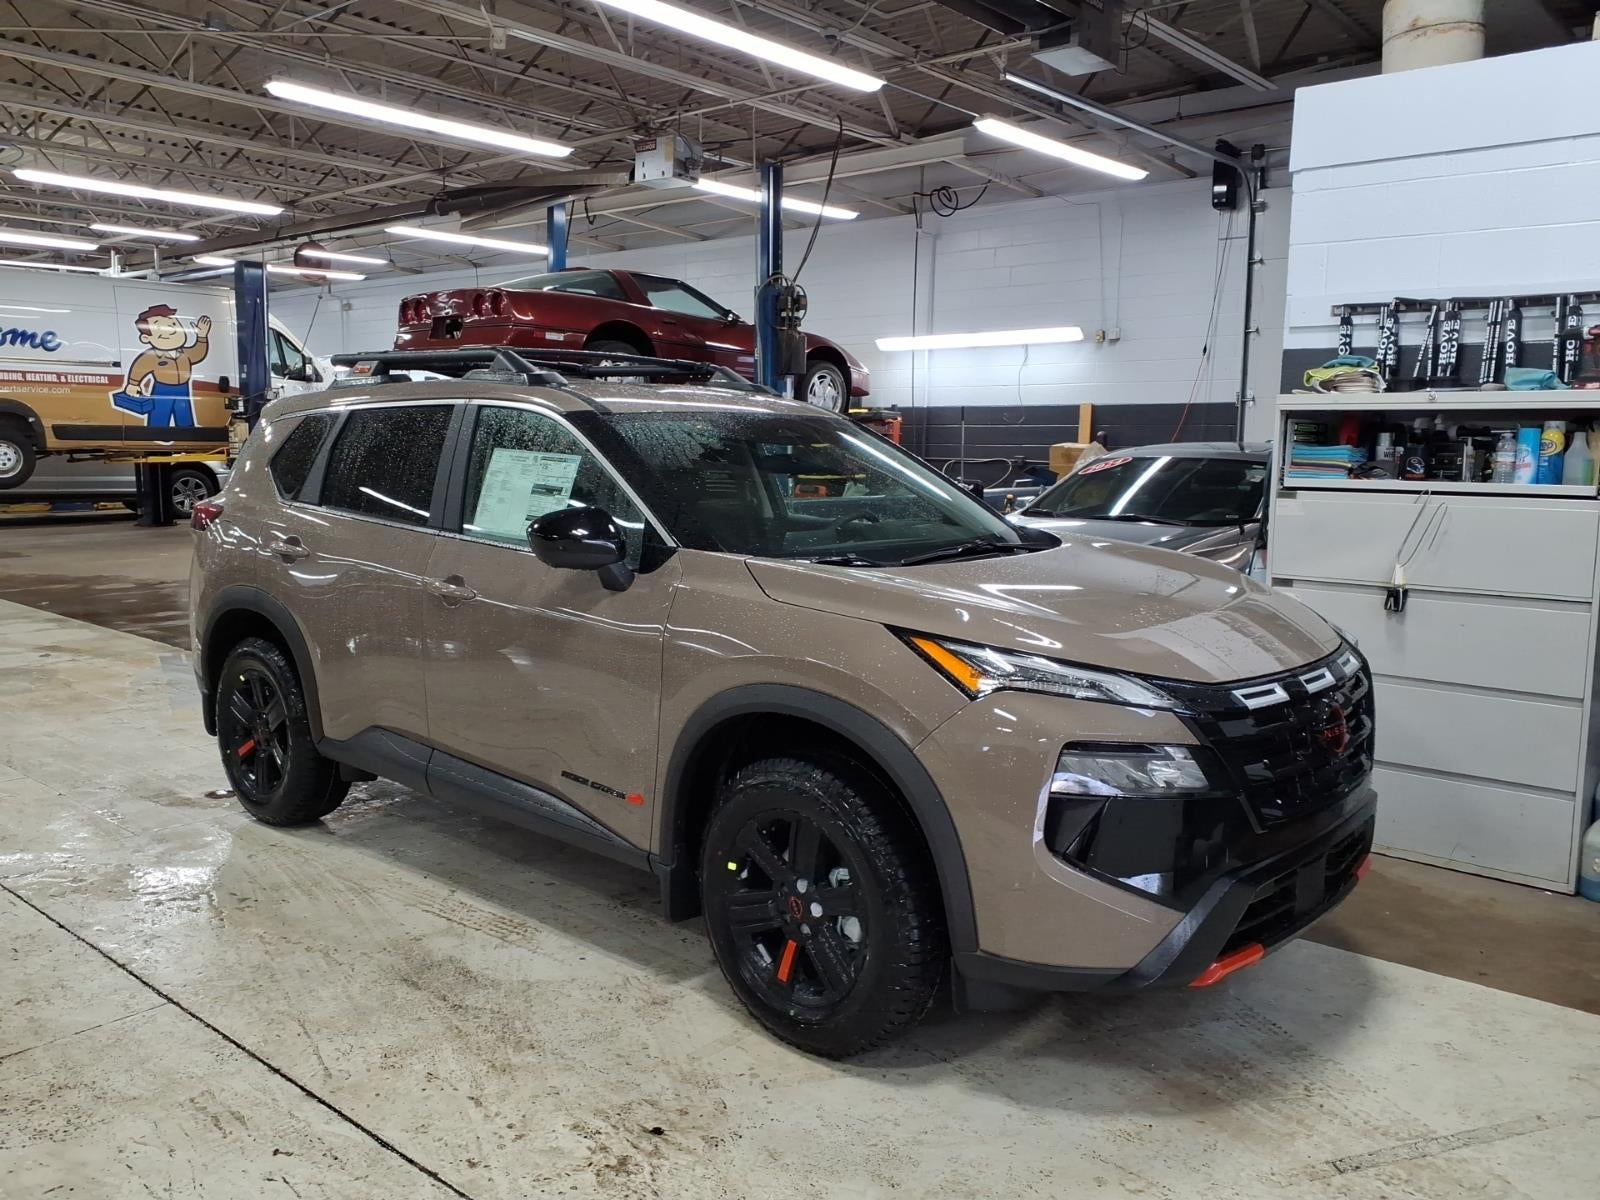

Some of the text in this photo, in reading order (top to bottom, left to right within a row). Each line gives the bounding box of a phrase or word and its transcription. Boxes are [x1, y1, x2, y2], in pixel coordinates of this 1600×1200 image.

[1376, 317, 1395, 360] HOVE
[1438, 319, 1451, 365] HOVE
[1505, 319, 1516, 365] HOVE
[1565, 315, 1577, 362] HOE
[67, 374, 109, 384] ELECTRICAL
